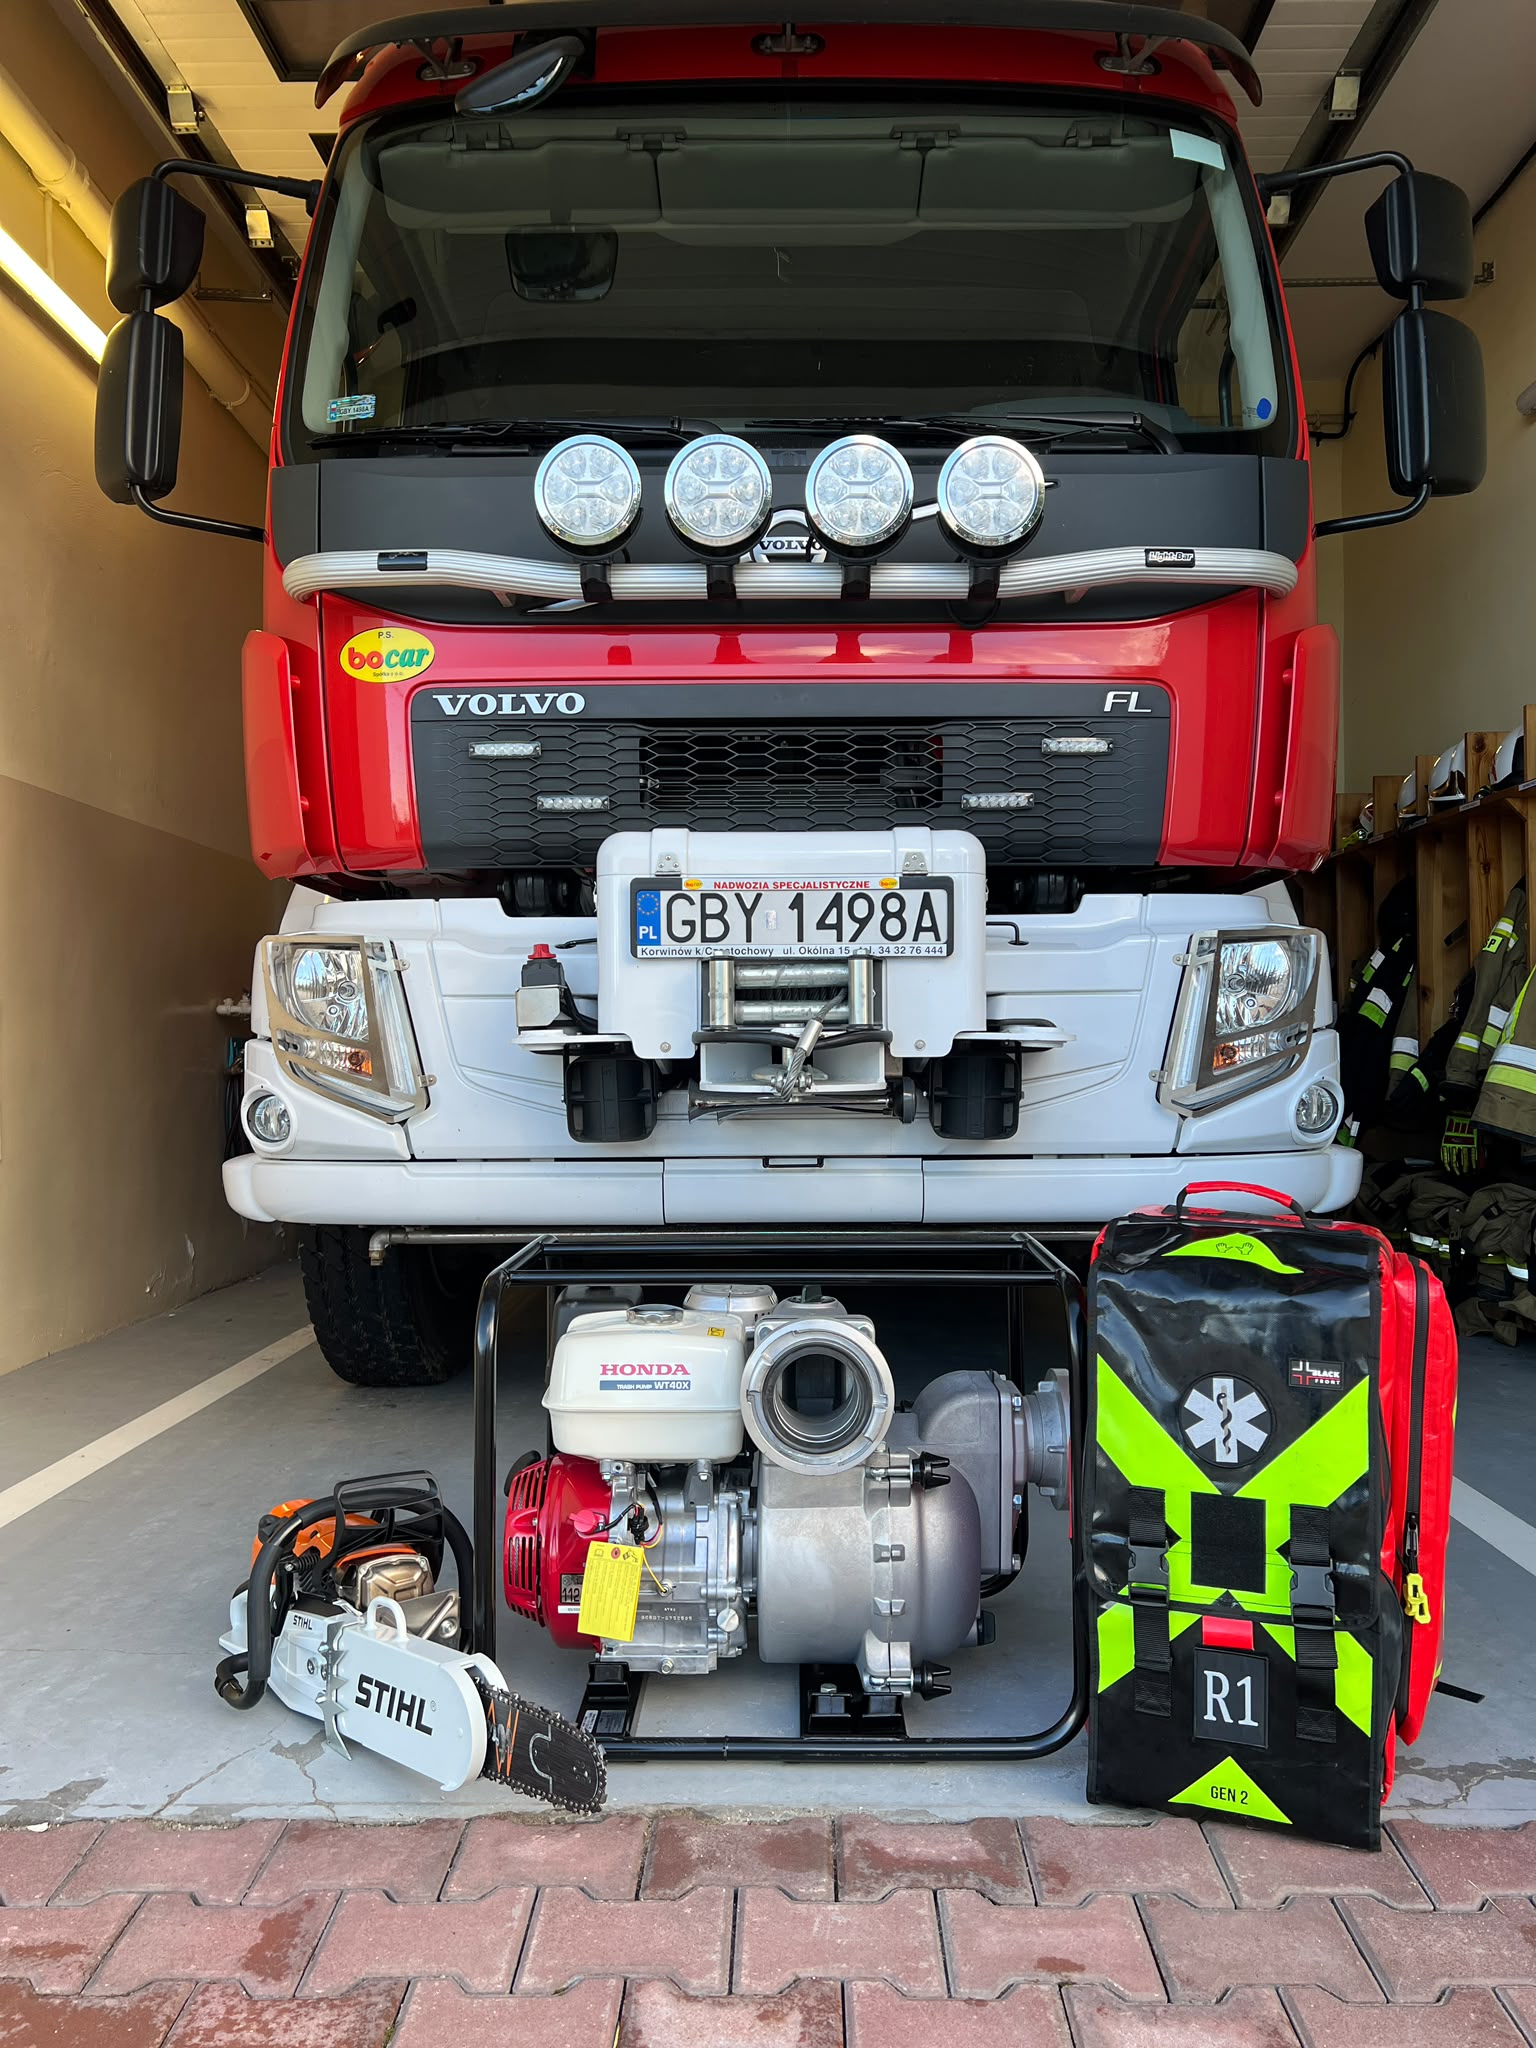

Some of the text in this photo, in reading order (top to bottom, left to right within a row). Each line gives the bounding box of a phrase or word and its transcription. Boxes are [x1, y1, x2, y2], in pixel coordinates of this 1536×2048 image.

[347, 646, 430, 670] bocar
[432, 692, 586, 716] VOLVO
[1103, 691, 1152, 713] FL
[713, 880, 870, 890] NADWOZIA SPECJALISTYCZNE
[666, 891, 942, 944] GBY 1498A
[638, 925, 658, 940] PL
[640, 946, 692, 956] Korwinów
[783, 946, 796, 955] ul.
[798, 946, 835, 955] Okólna
[838, 946, 850, 954] 15
[878, 946, 890, 954] 34
[894, 946, 906, 954] 32
[909, 946, 922, 954] 76
[924, 945, 943, 954] 444
[600, 1364, 691, 1376] HONDA
[1312, 1370, 1340, 1378] BLACK
[654, 1381, 690, 1390] WT40X
[562, 1588, 580, 1602] 112
[292, 1614, 313, 1630] STIHL
[354, 1673, 433, 1736] STIHL
[1203, 1670, 1259, 1727] R1
[1210, 1786, 1249, 1805] GEN 2
